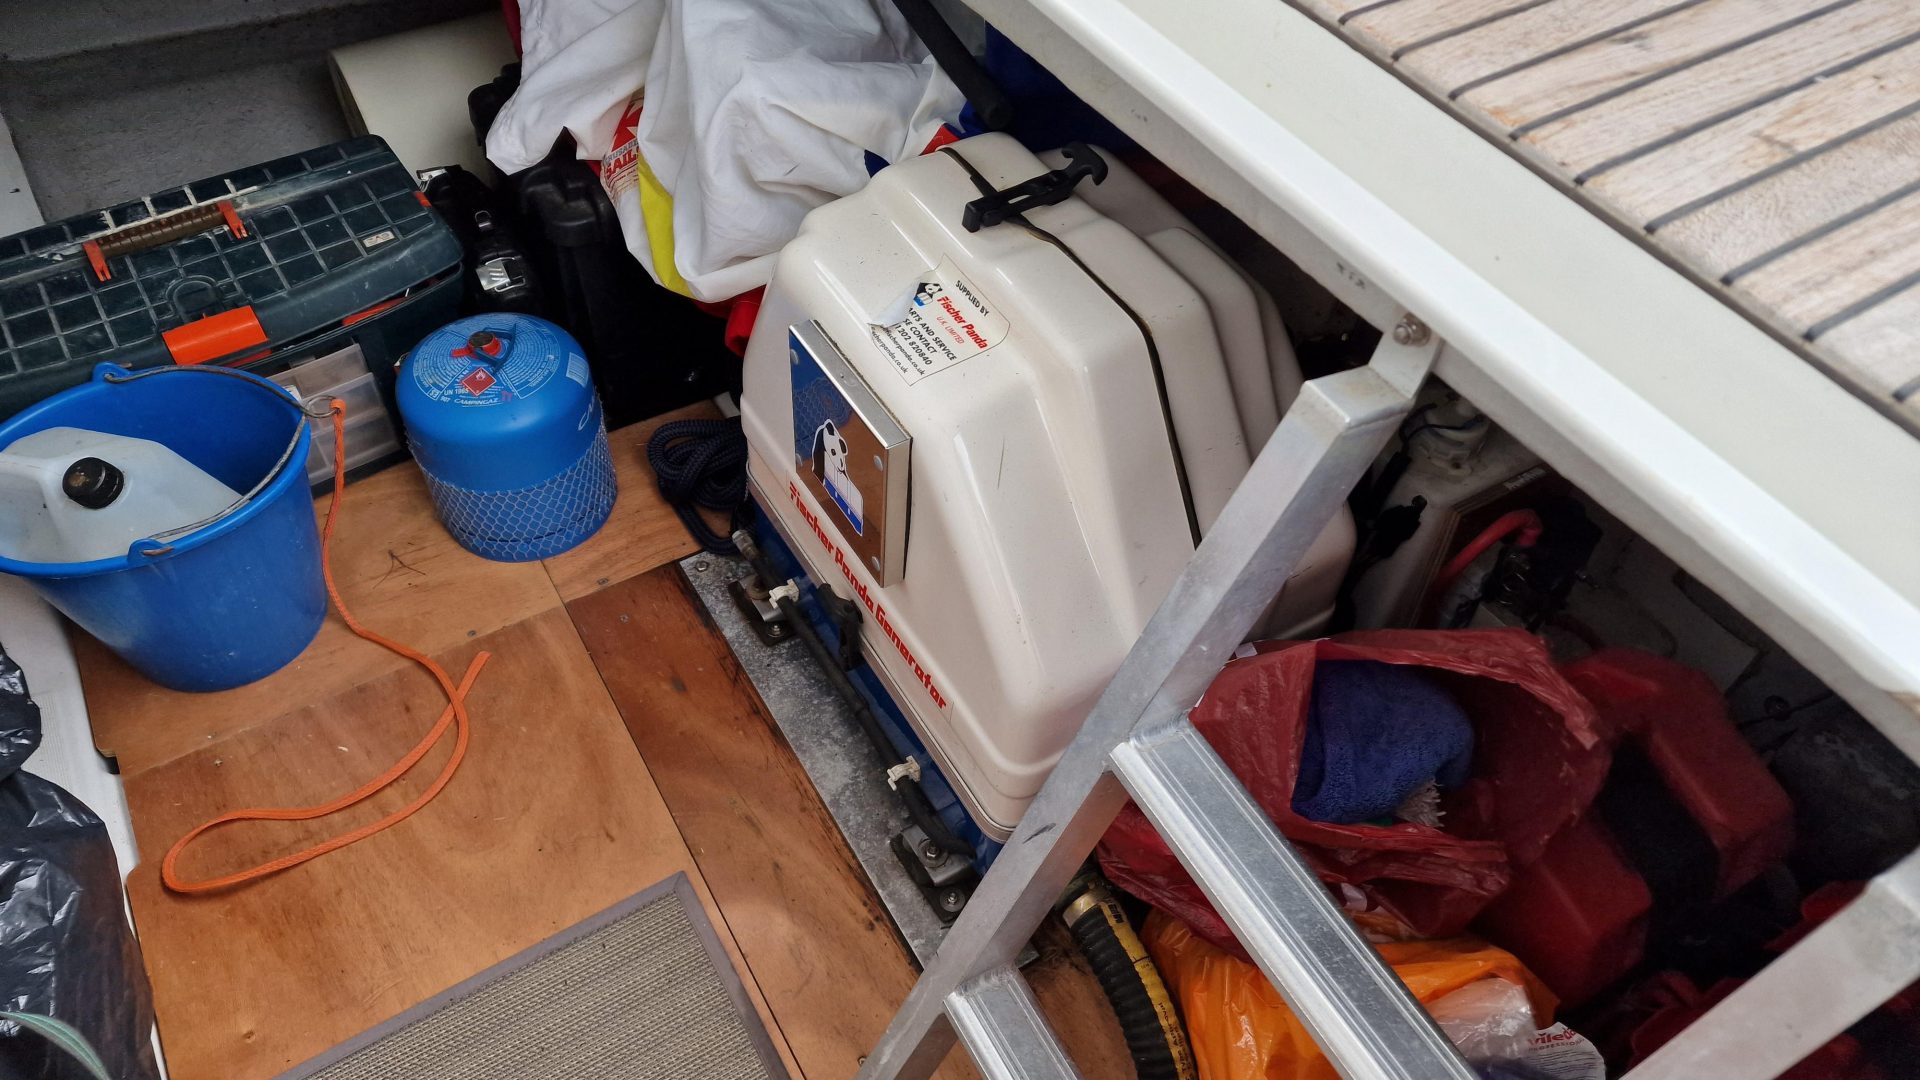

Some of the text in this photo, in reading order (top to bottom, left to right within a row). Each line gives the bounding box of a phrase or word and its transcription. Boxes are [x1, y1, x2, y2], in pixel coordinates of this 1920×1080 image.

[605, 139, 639, 165] CRUSADE
[956, 280, 990, 317] SUPPLIED BY
[903, 318, 937, 354] SE CONTACT
[908, 307, 957, 361] ARTS AND SERVICE
[937, 296, 988, 349] Fischer Panda
[945, 325, 965, 344] LIMITED
[884, 328, 925, 376] fischerpanda.co.uk
[895, 325, 933, 366] 1202 820840
[789, 481, 947, 709] Fischer Panda Generator
